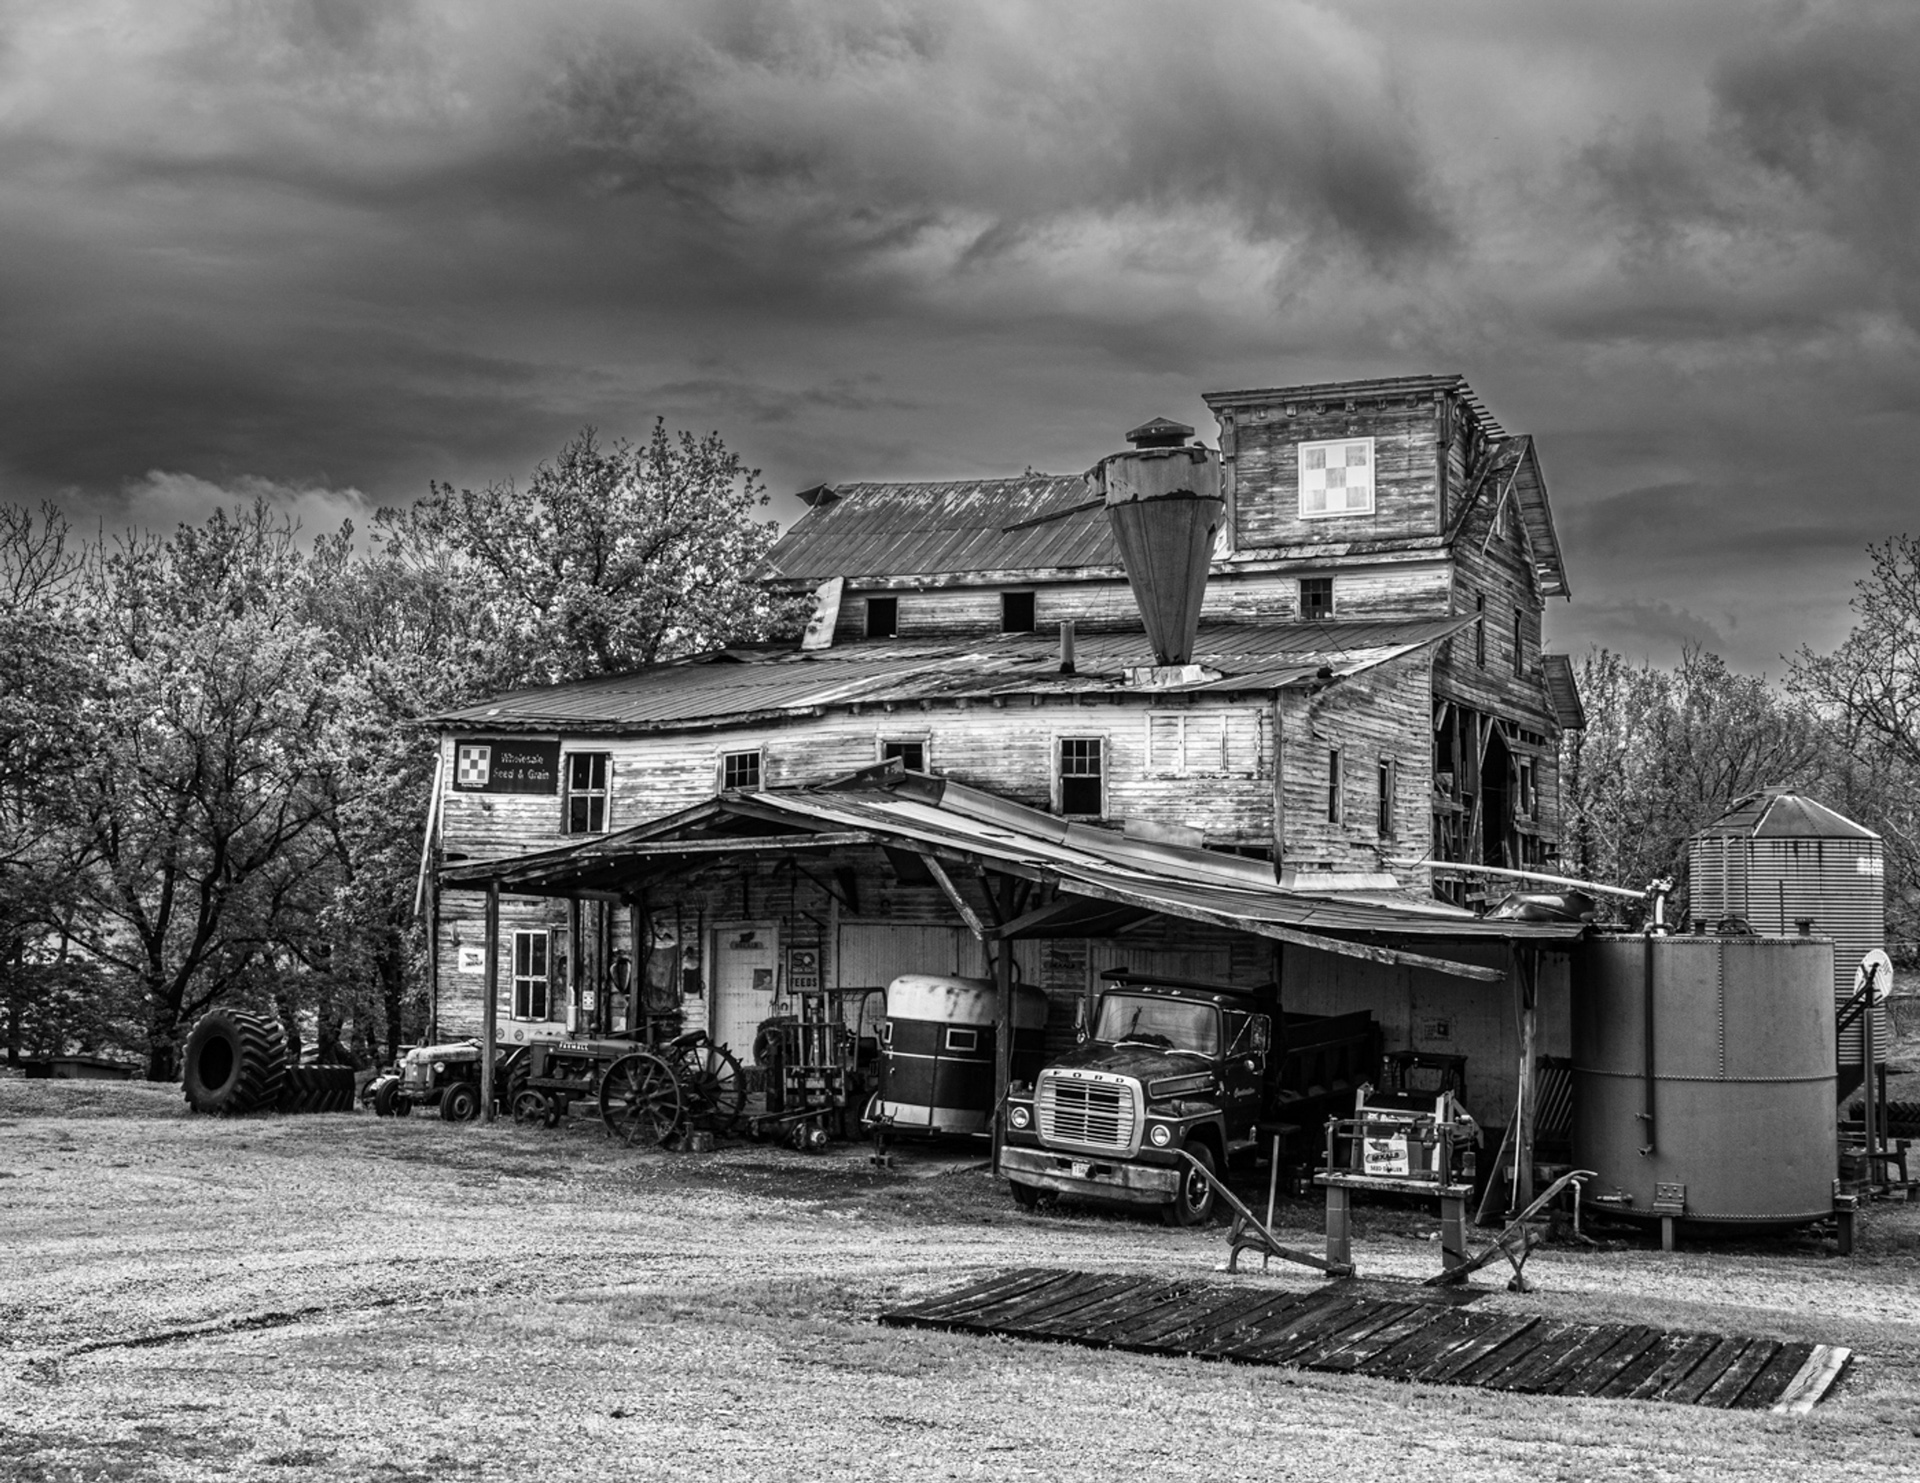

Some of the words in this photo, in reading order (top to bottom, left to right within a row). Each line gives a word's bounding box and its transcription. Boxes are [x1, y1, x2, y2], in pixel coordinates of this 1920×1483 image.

[501, 752, 544, 765] Wholesale
[517, 768, 525, 779] &
[527, 768, 550, 780] Grain
[790, 977, 817, 988] FEEDS
[1053, 1070, 1125, 1084] FORD
